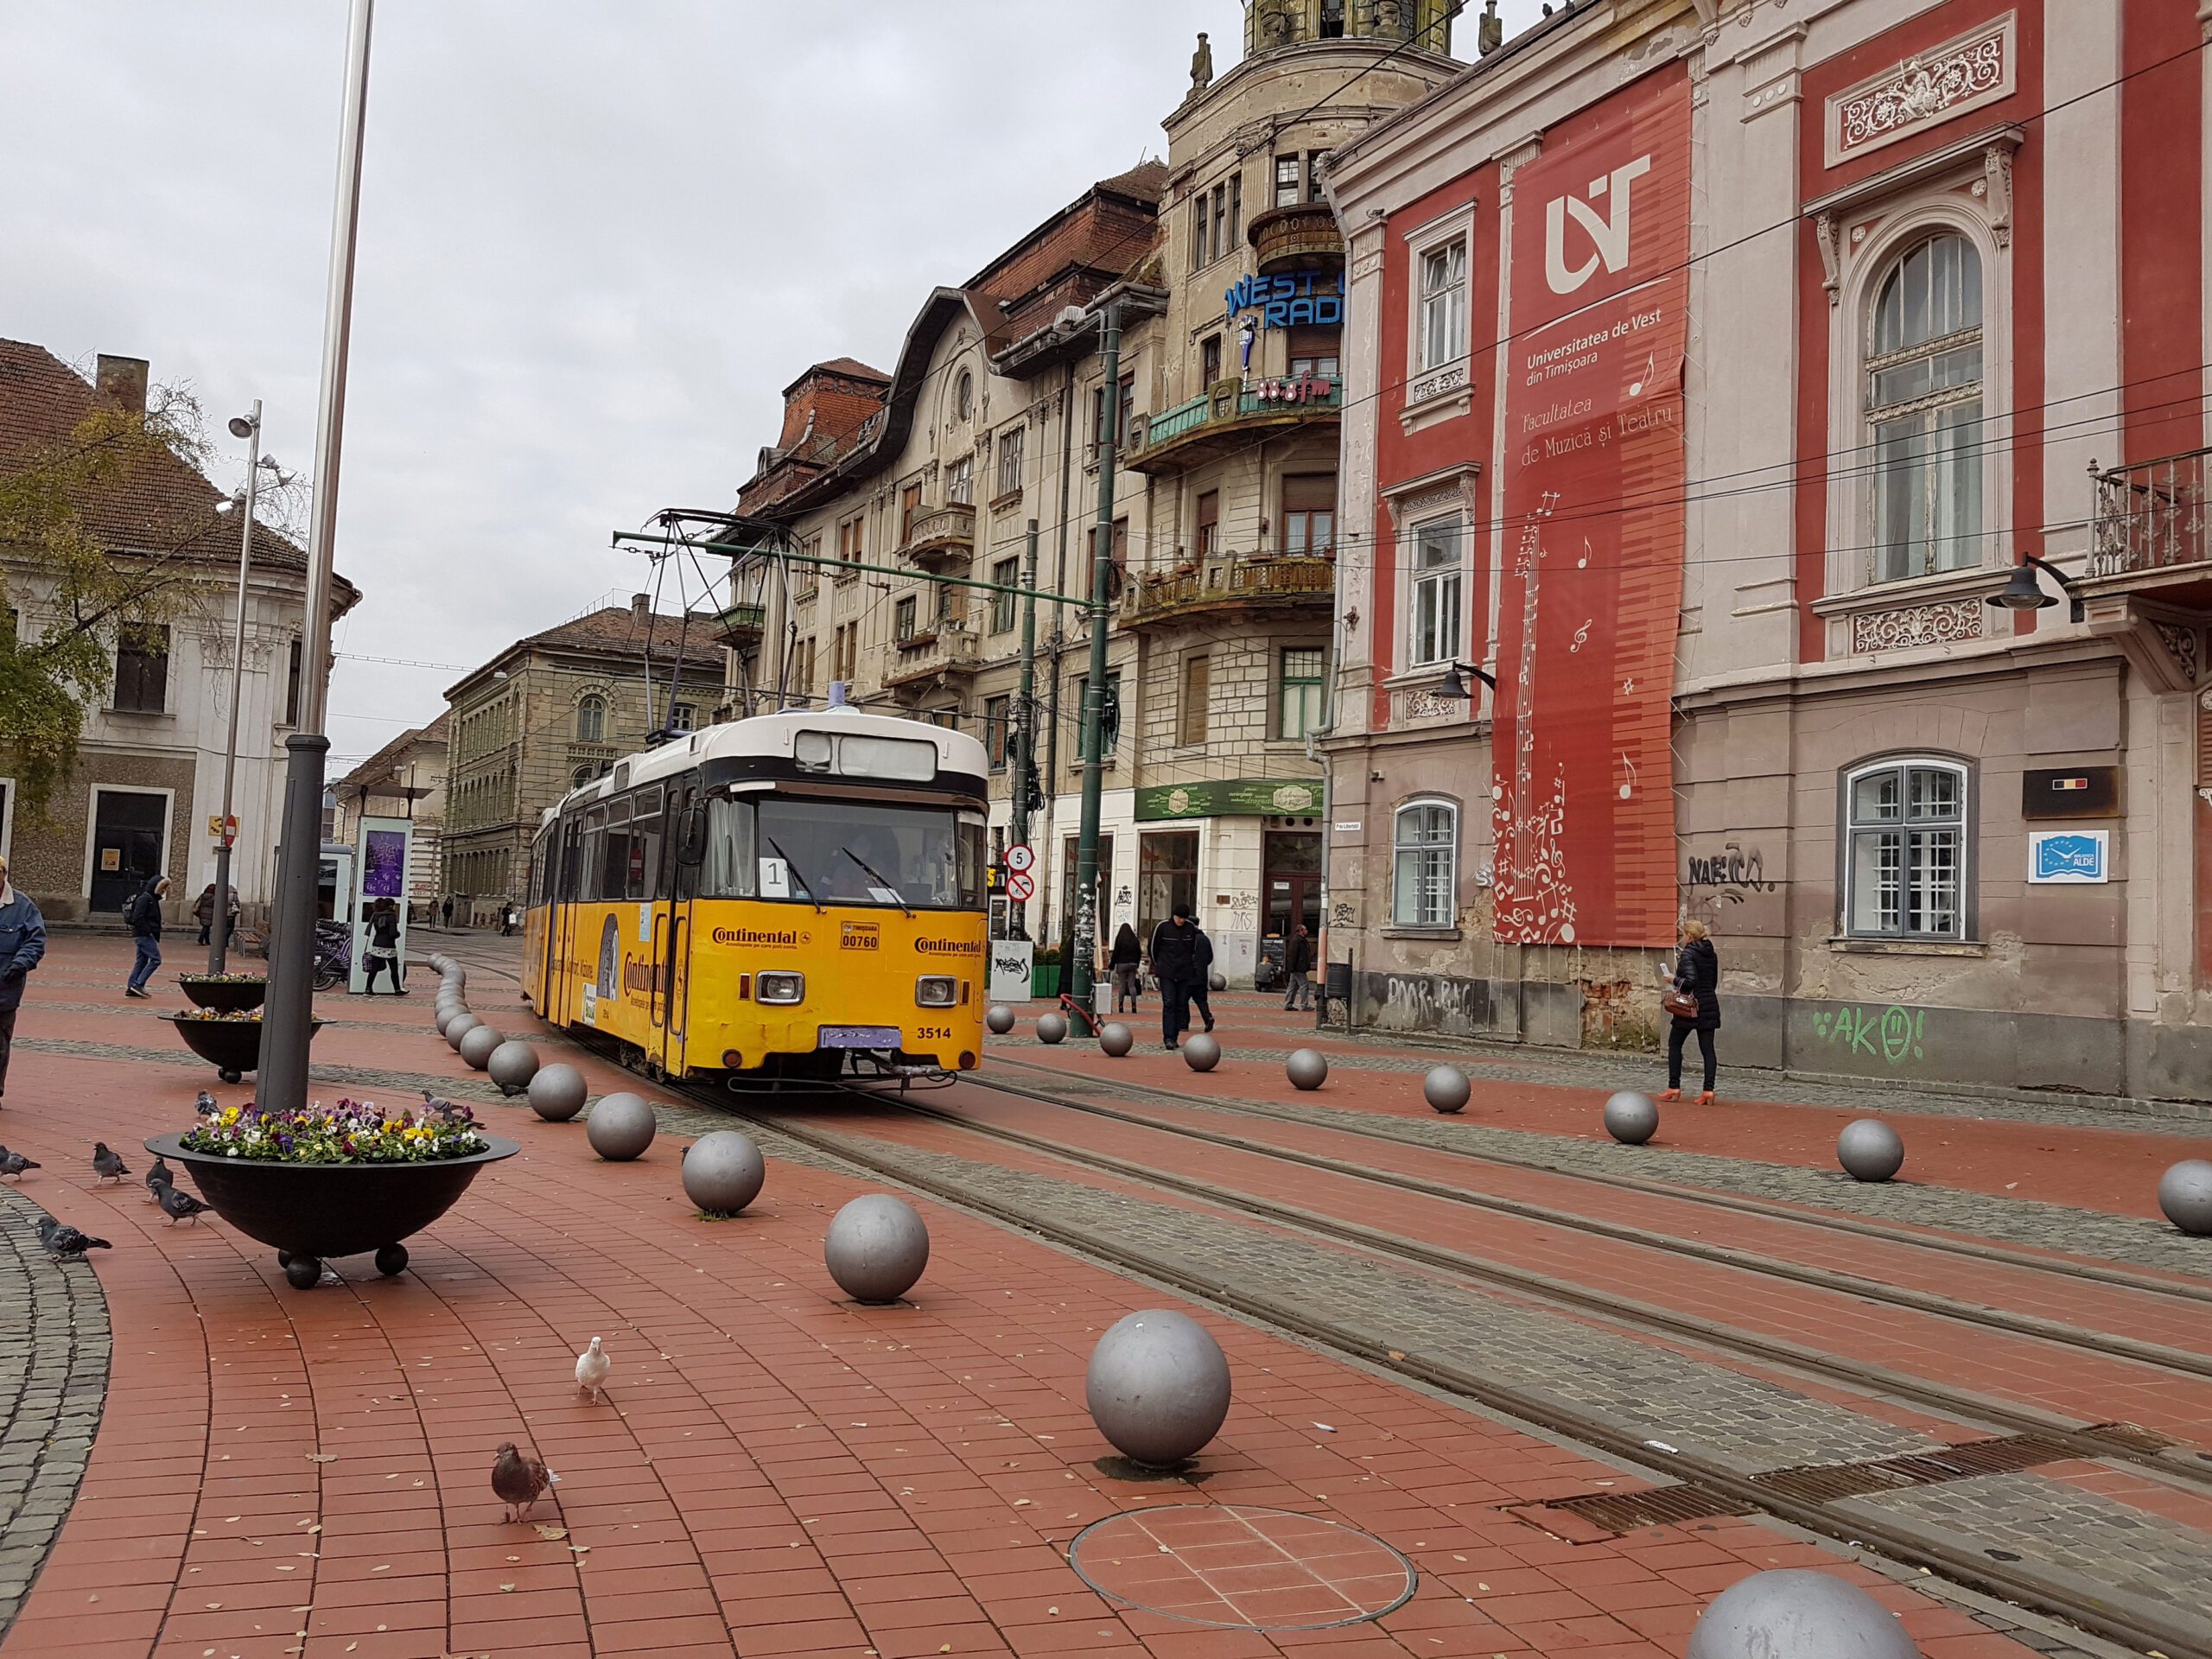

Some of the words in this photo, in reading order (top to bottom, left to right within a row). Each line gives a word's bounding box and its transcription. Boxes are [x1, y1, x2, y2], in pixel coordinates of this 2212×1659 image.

[1224, 270, 1321, 319] WEST
[1528, 330, 1608, 369] Universitatea
[1612, 321, 1629, 338] de
[1631, 308, 1662, 330] Vest
[1527, 370, 1542, 386] din
[1522, 398, 1592, 433] Facultatea
[1522, 443, 1539, 467] de
[1545, 427, 1592, 458] Muzică
[1618, 407, 1673, 435] Teatru
[1016, 852, 1023, 865] 5
[768, 862, 782, 885] 1
[712, 926, 797, 944] Continental
[842, 936, 877, 948] 00760
[914, 937, 982, 954] Continental
[917, 1027, 951, 1039] 3514
